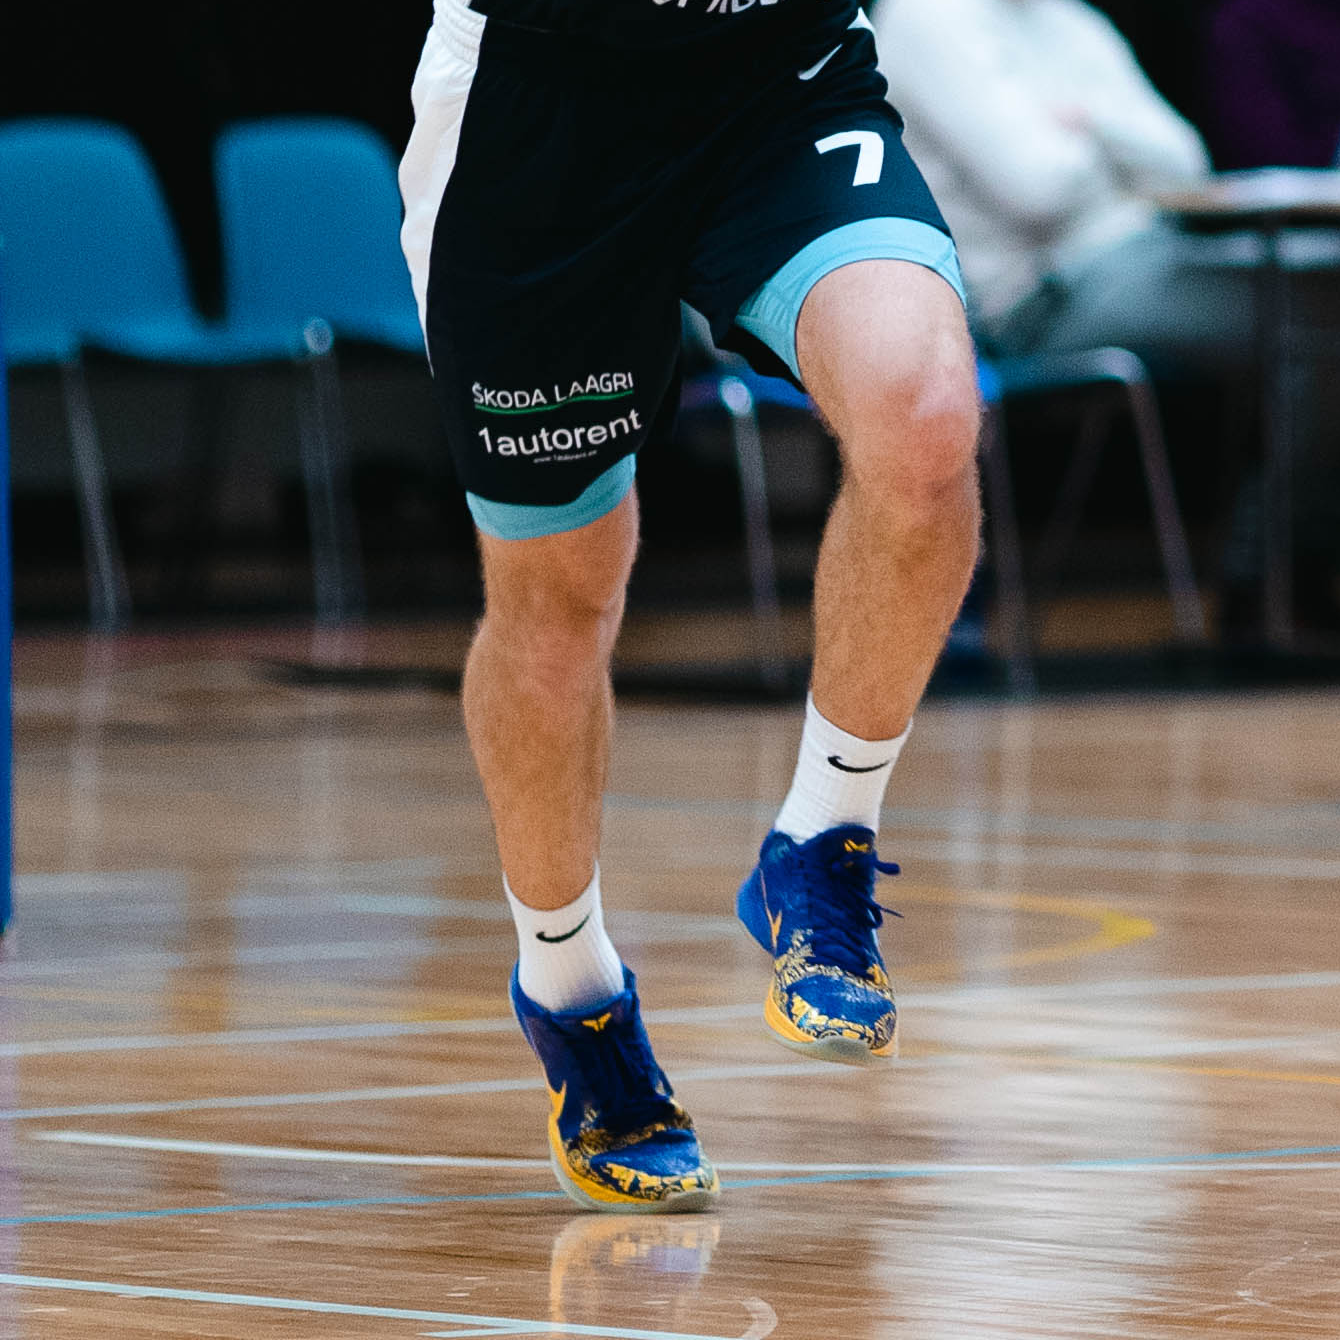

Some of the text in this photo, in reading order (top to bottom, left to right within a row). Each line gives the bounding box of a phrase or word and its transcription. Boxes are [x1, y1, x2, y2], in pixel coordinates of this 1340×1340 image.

[814, 130, 885, 187] 7
[471, 371, 634, 408] ŠKODA LAAGRI
[478, 408, 642, 457] 1autorent
